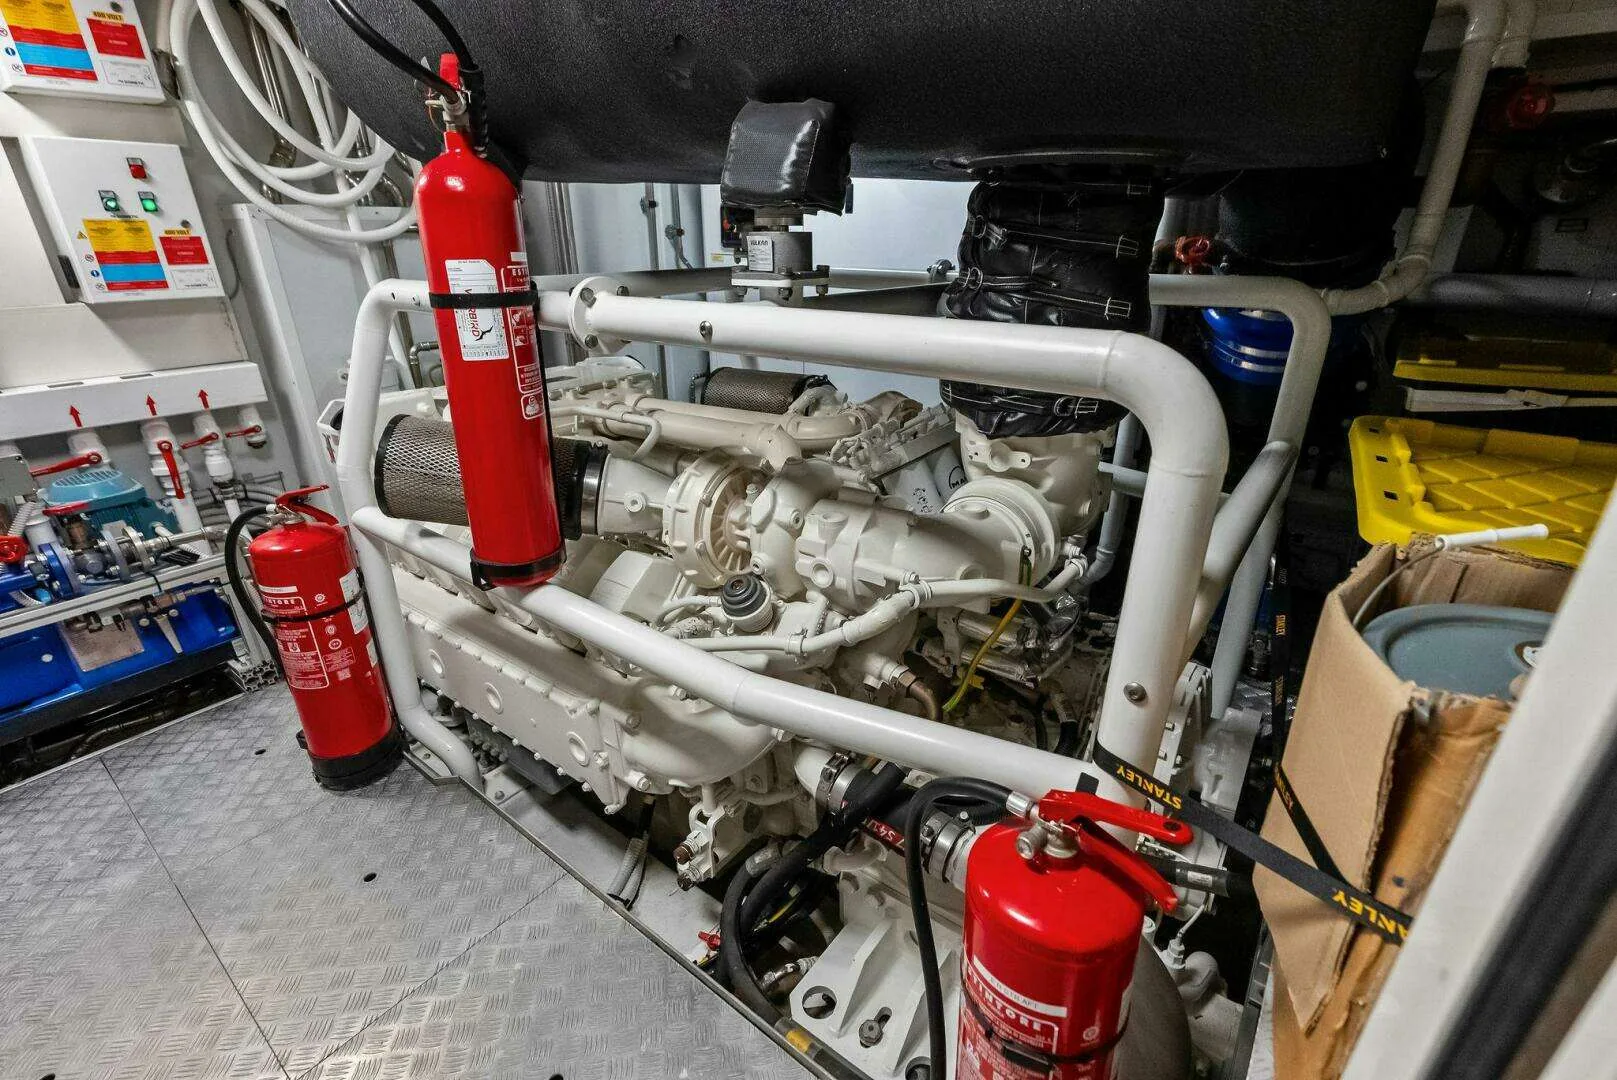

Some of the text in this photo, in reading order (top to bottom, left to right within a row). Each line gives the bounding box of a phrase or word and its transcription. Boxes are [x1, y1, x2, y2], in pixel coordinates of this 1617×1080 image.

[950, 478, 968, 489] MA
[1116, 765, 1182, 810] STANLEY
[1332, 889, 1409, 937] ANLEY
